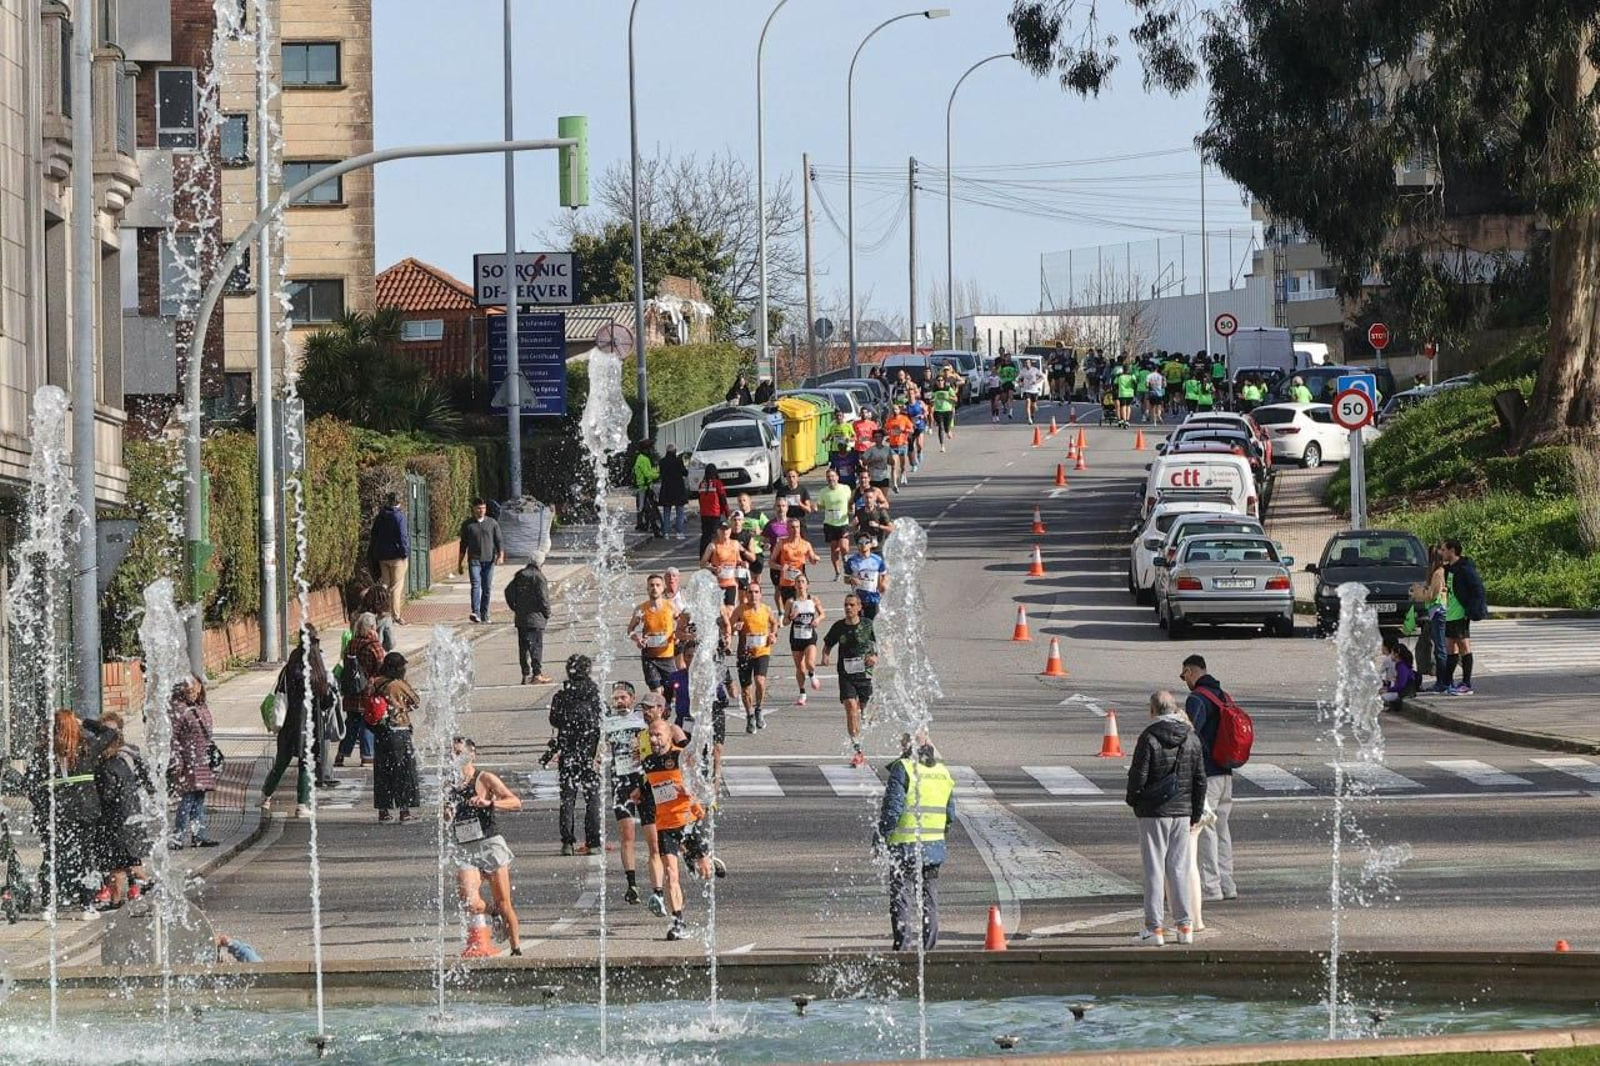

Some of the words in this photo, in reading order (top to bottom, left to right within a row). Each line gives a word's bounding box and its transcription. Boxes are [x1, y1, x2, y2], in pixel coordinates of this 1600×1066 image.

[482, 264, 567, 282] SORONIC
[483, 284, 567, 301] DF-ERVER
[1220, 321, 1232, 329] 50
[1343, 403, 1363, 415] 50
[1171, 468, 1200, 486] ctt
